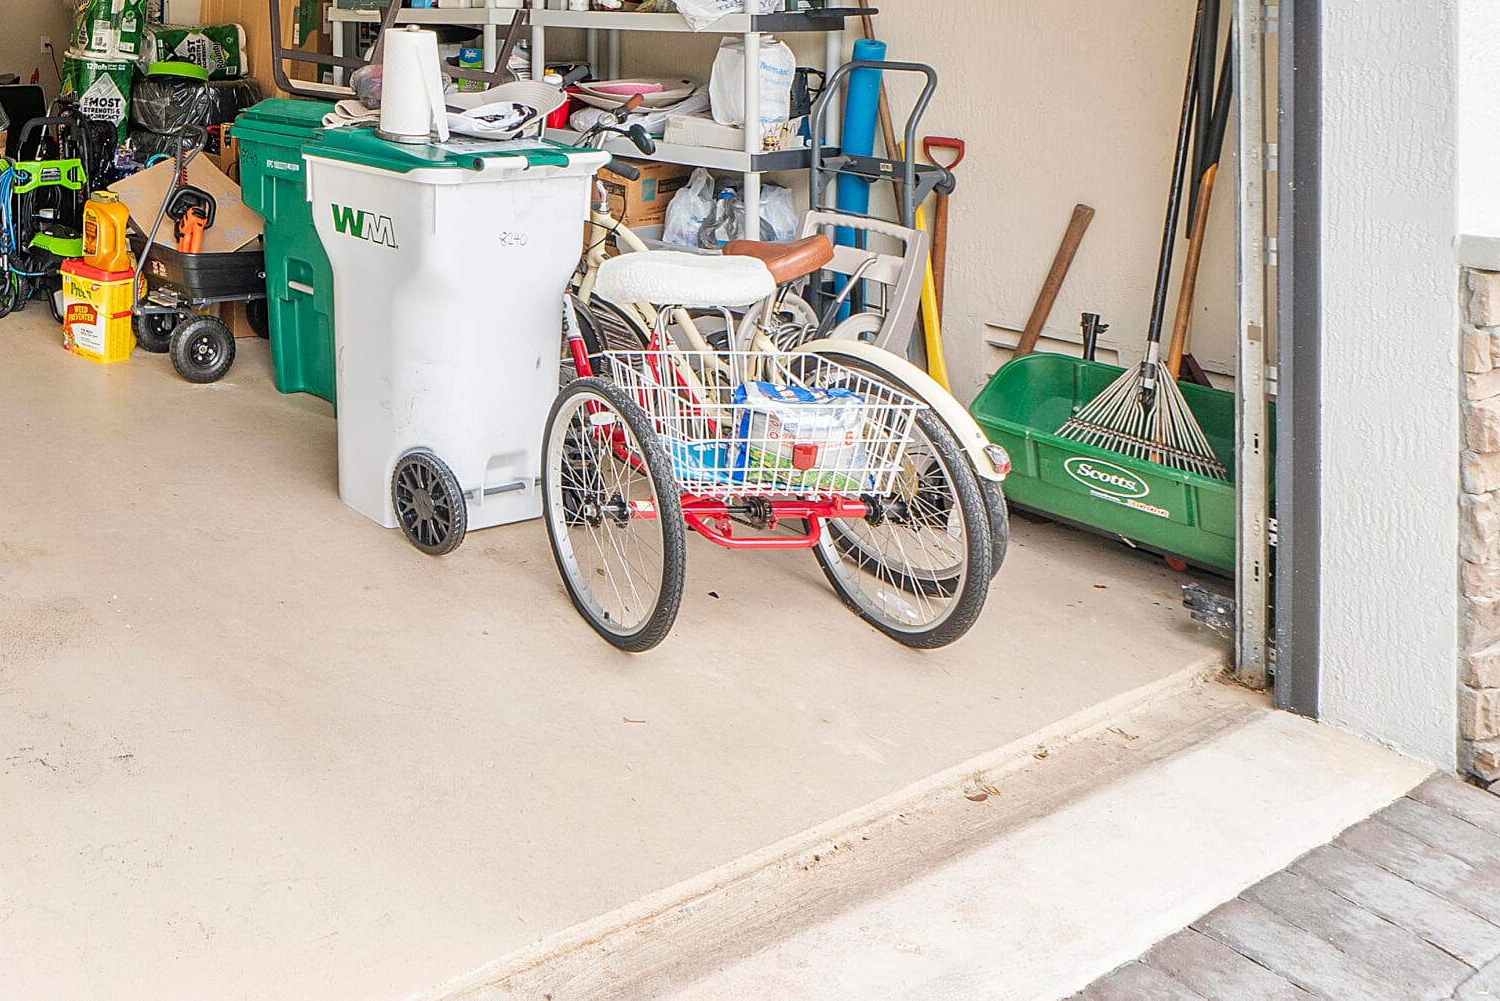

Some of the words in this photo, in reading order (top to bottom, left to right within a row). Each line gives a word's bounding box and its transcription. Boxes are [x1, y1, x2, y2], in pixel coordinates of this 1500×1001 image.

[187, 39, 196, 62] OST
[89, 97, 121, 108] MOST
[331, 203, 396, 249] WM
[499, 231, 529, 247] 8240
[70, 282, 92, 300] Preen
[73, 305, 89, 314] WEED
[1076, 463, 1138, 492] Scotts
